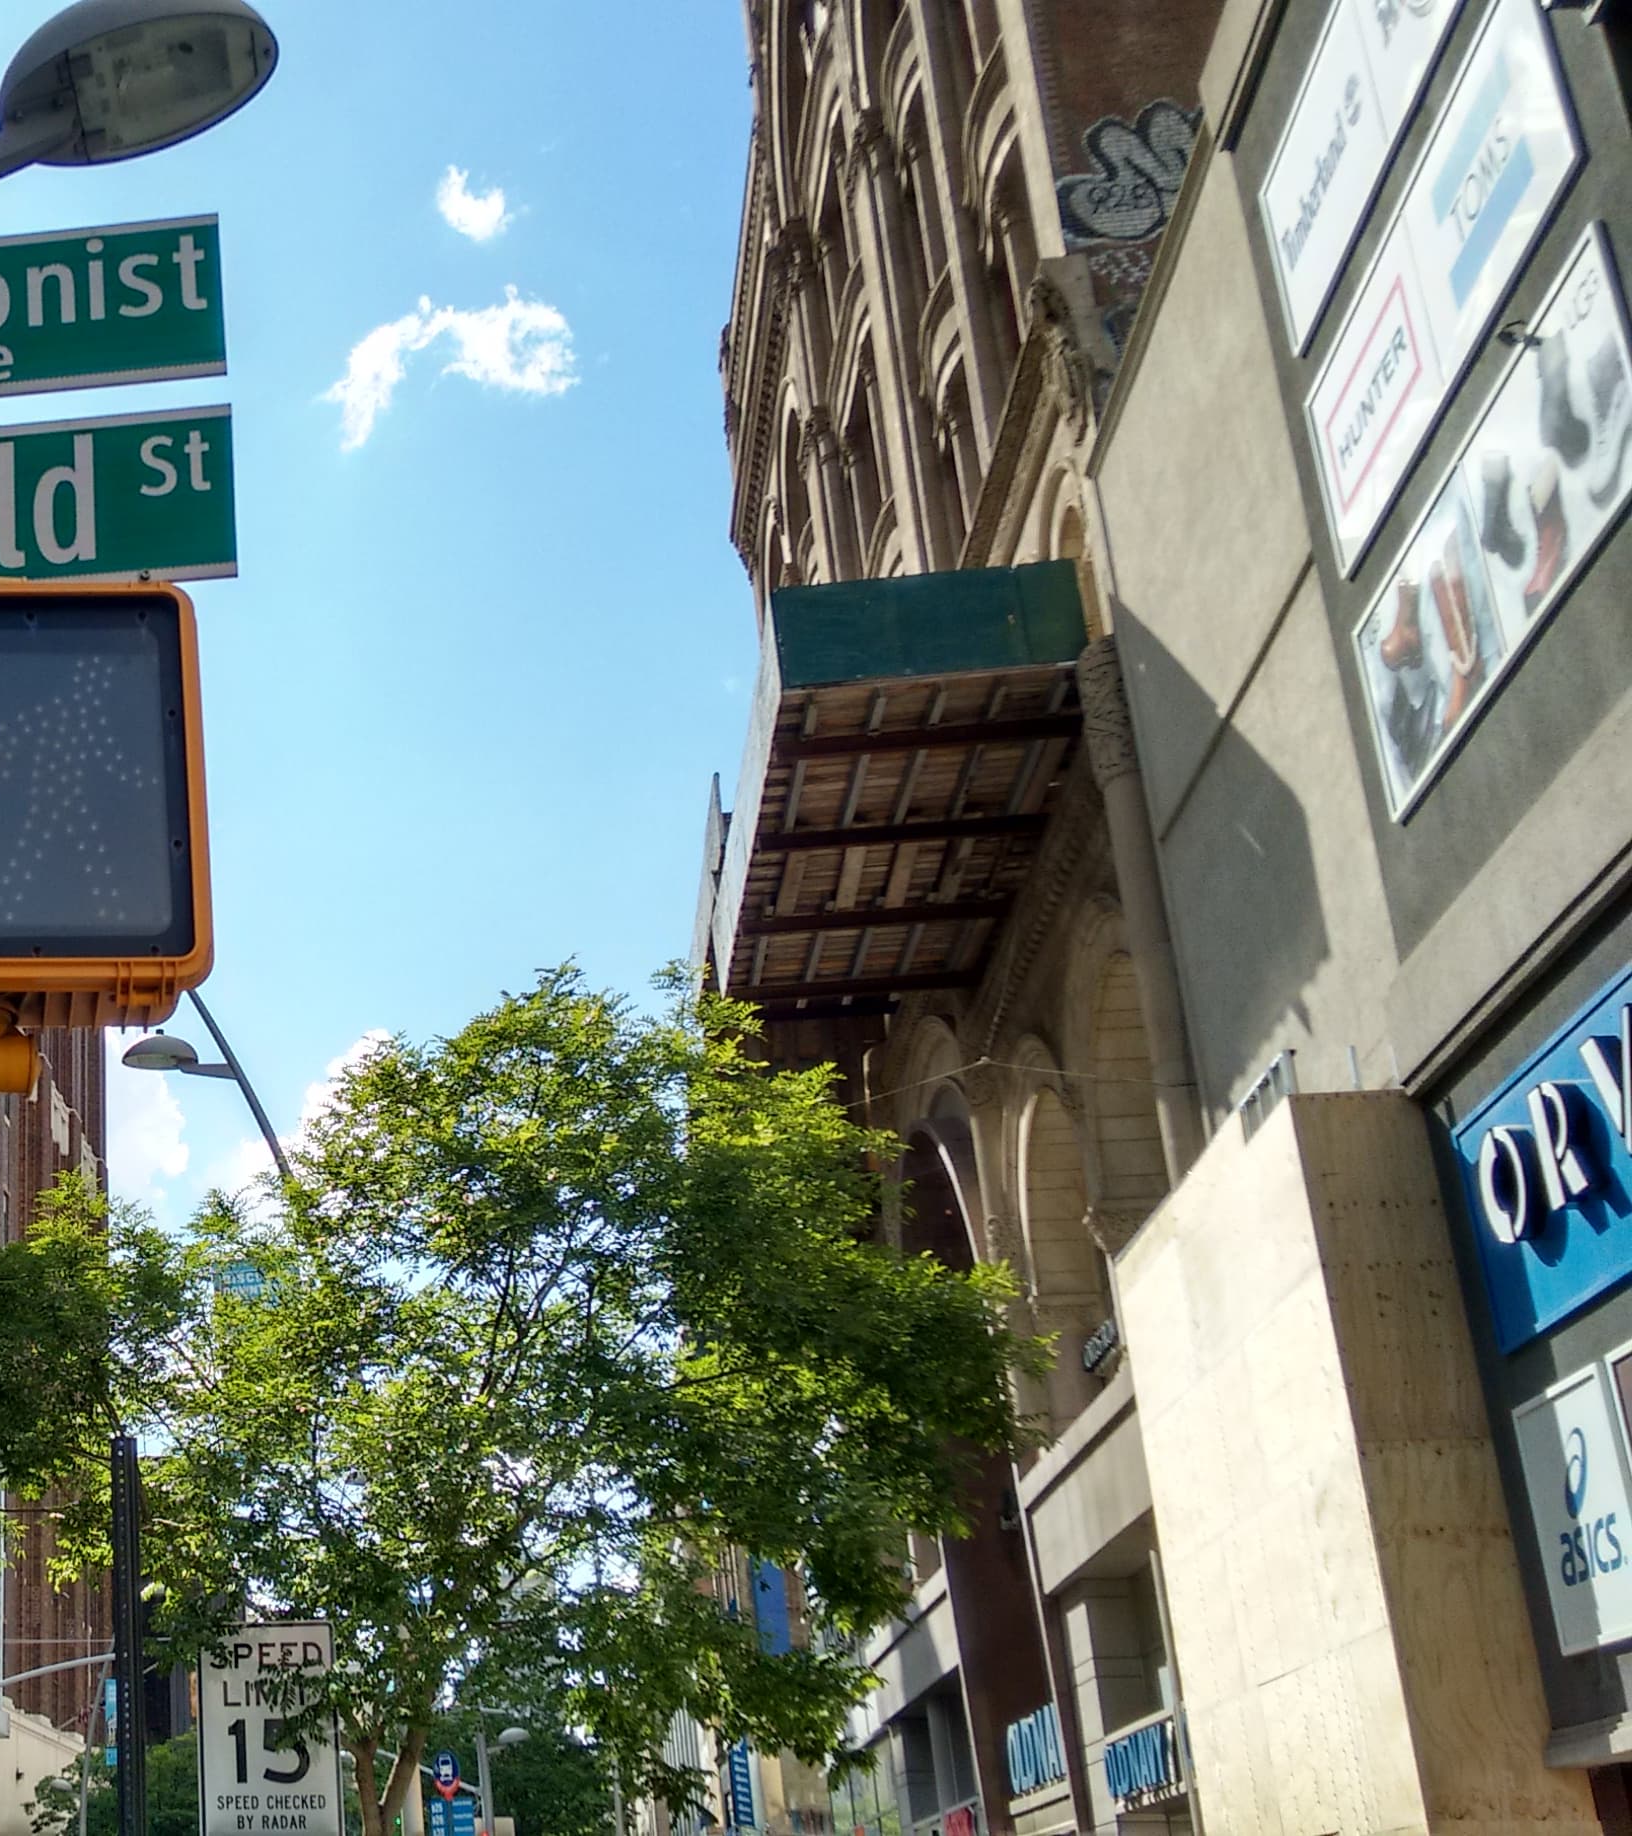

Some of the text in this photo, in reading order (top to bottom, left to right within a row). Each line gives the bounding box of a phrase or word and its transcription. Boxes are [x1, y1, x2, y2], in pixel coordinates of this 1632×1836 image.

[1450, 117, 1511, 243] TOMS
[1338, 325, 1408, 470] HUNTER
[139, 430, 211, 497] St
[210, 1642, 323, 1669] SPEED
[228, 1718, 310, 1784] 15
[217, 1795, 326, 1810] SPEED CHECKED
[237, 1815, 306, 1830] BY RADAR
